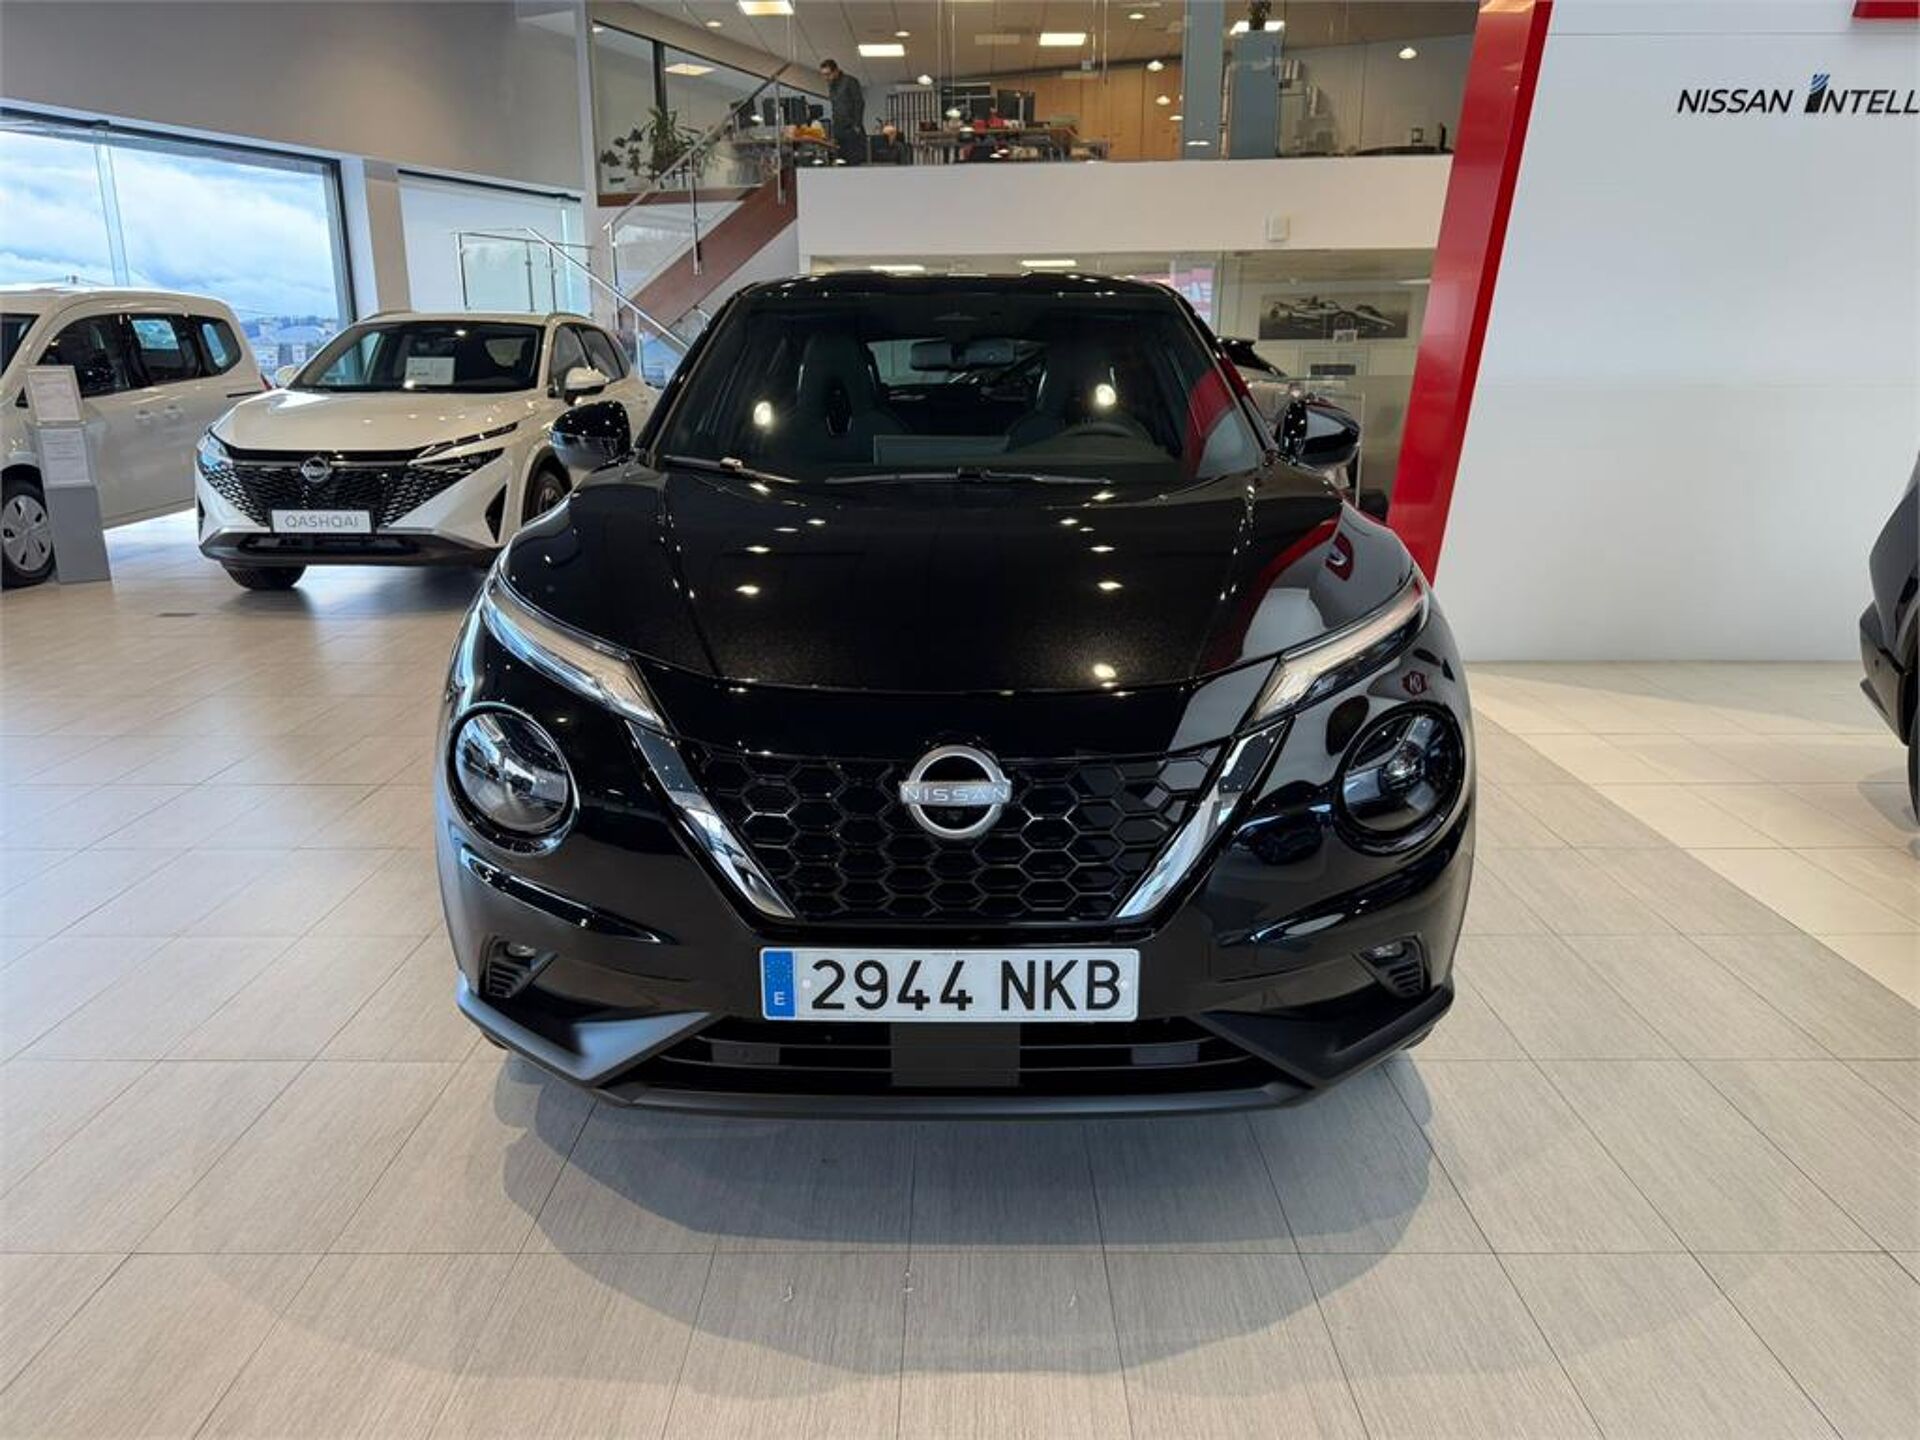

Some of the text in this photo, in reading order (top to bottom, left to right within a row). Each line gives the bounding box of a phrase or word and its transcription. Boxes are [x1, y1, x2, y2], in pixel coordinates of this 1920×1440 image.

[1677, 88, 1794, 115] NISSAN
[284, 514, 360, 529] QASHQAI
[904, 786, 1009, 802] NISSAN
[810, 958, 1122, 1011] 2944 NKB
[773, 991, 786, 1006] E
